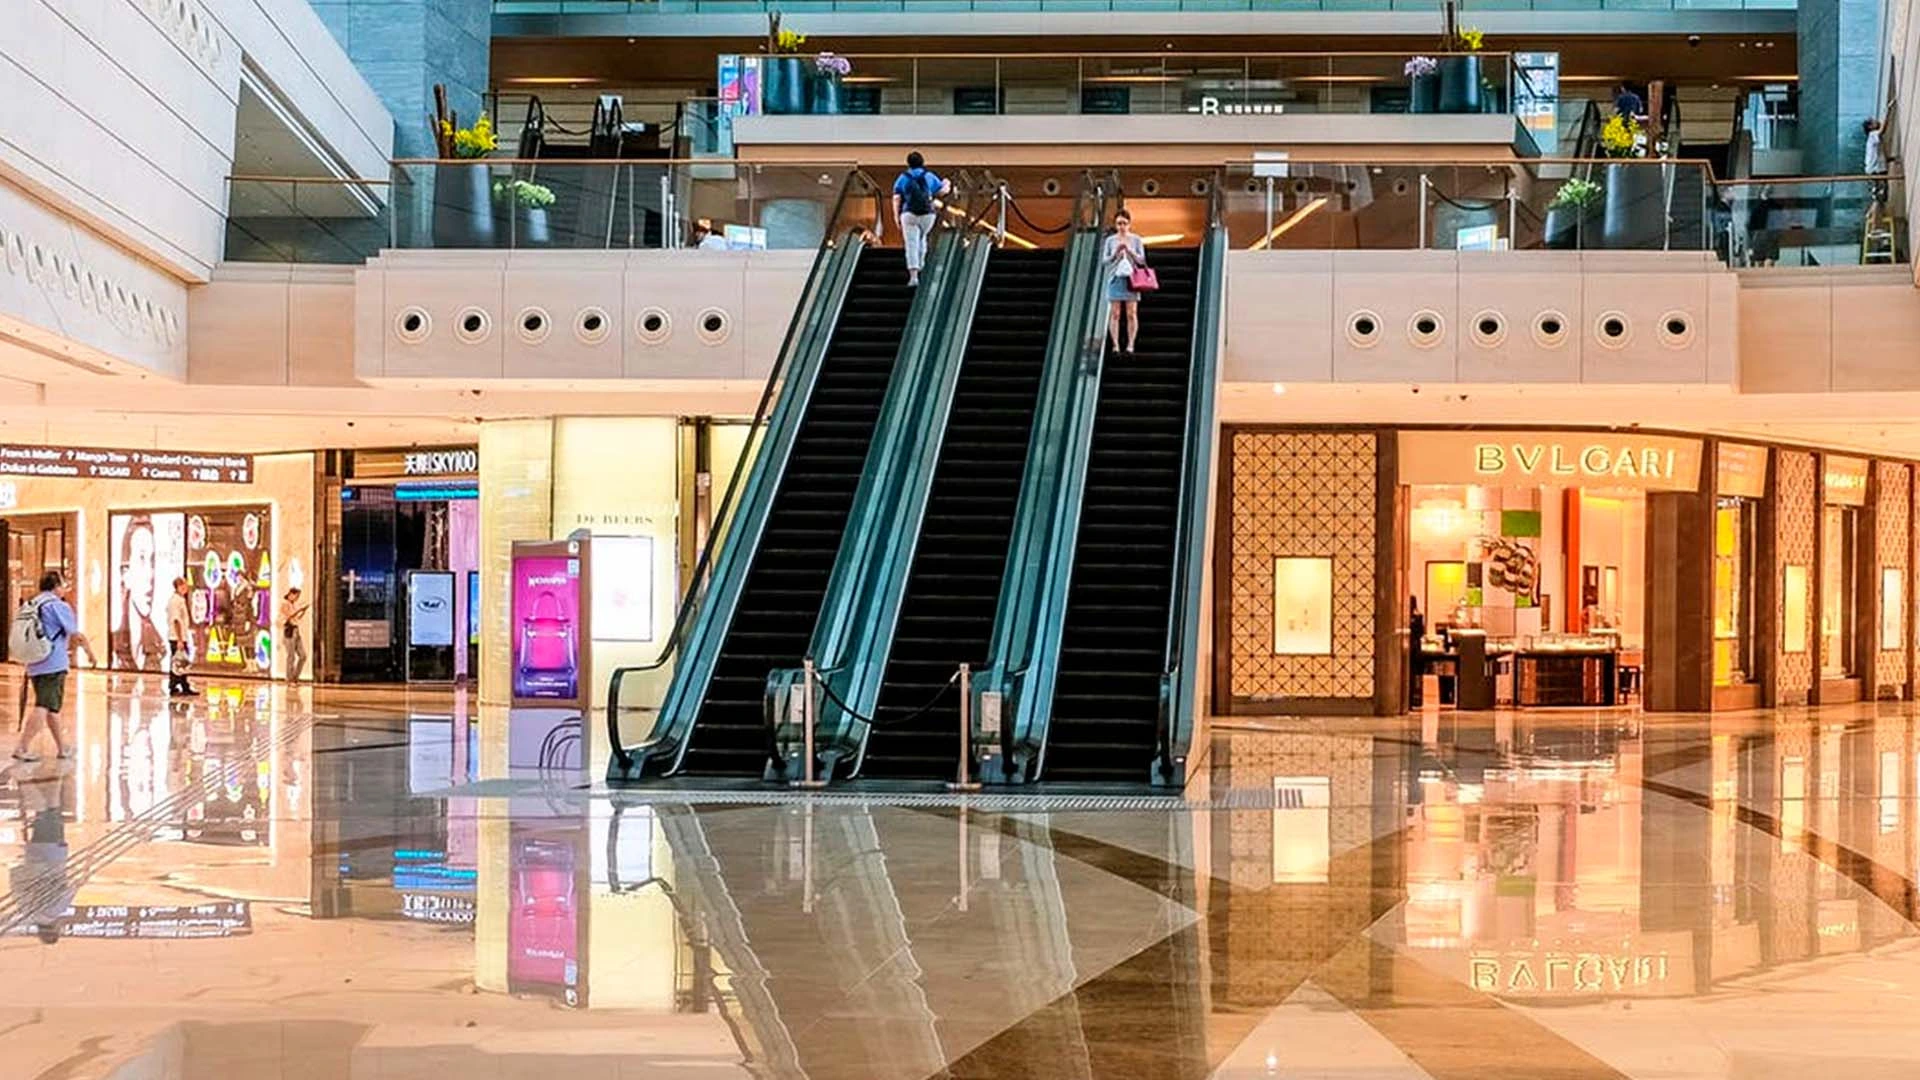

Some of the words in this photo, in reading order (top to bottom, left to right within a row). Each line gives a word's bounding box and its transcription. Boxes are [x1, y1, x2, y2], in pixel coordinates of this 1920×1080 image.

[76, 452, 107, 463] Mango
[142, 454, 181, 465] Standard
[182, 456, 224, 467] Chartered
[226, 457, 247, 468] Bank
[432, 450, 476, 472] SKY100
[1475, 443, 1675, 478] BVLGARI
